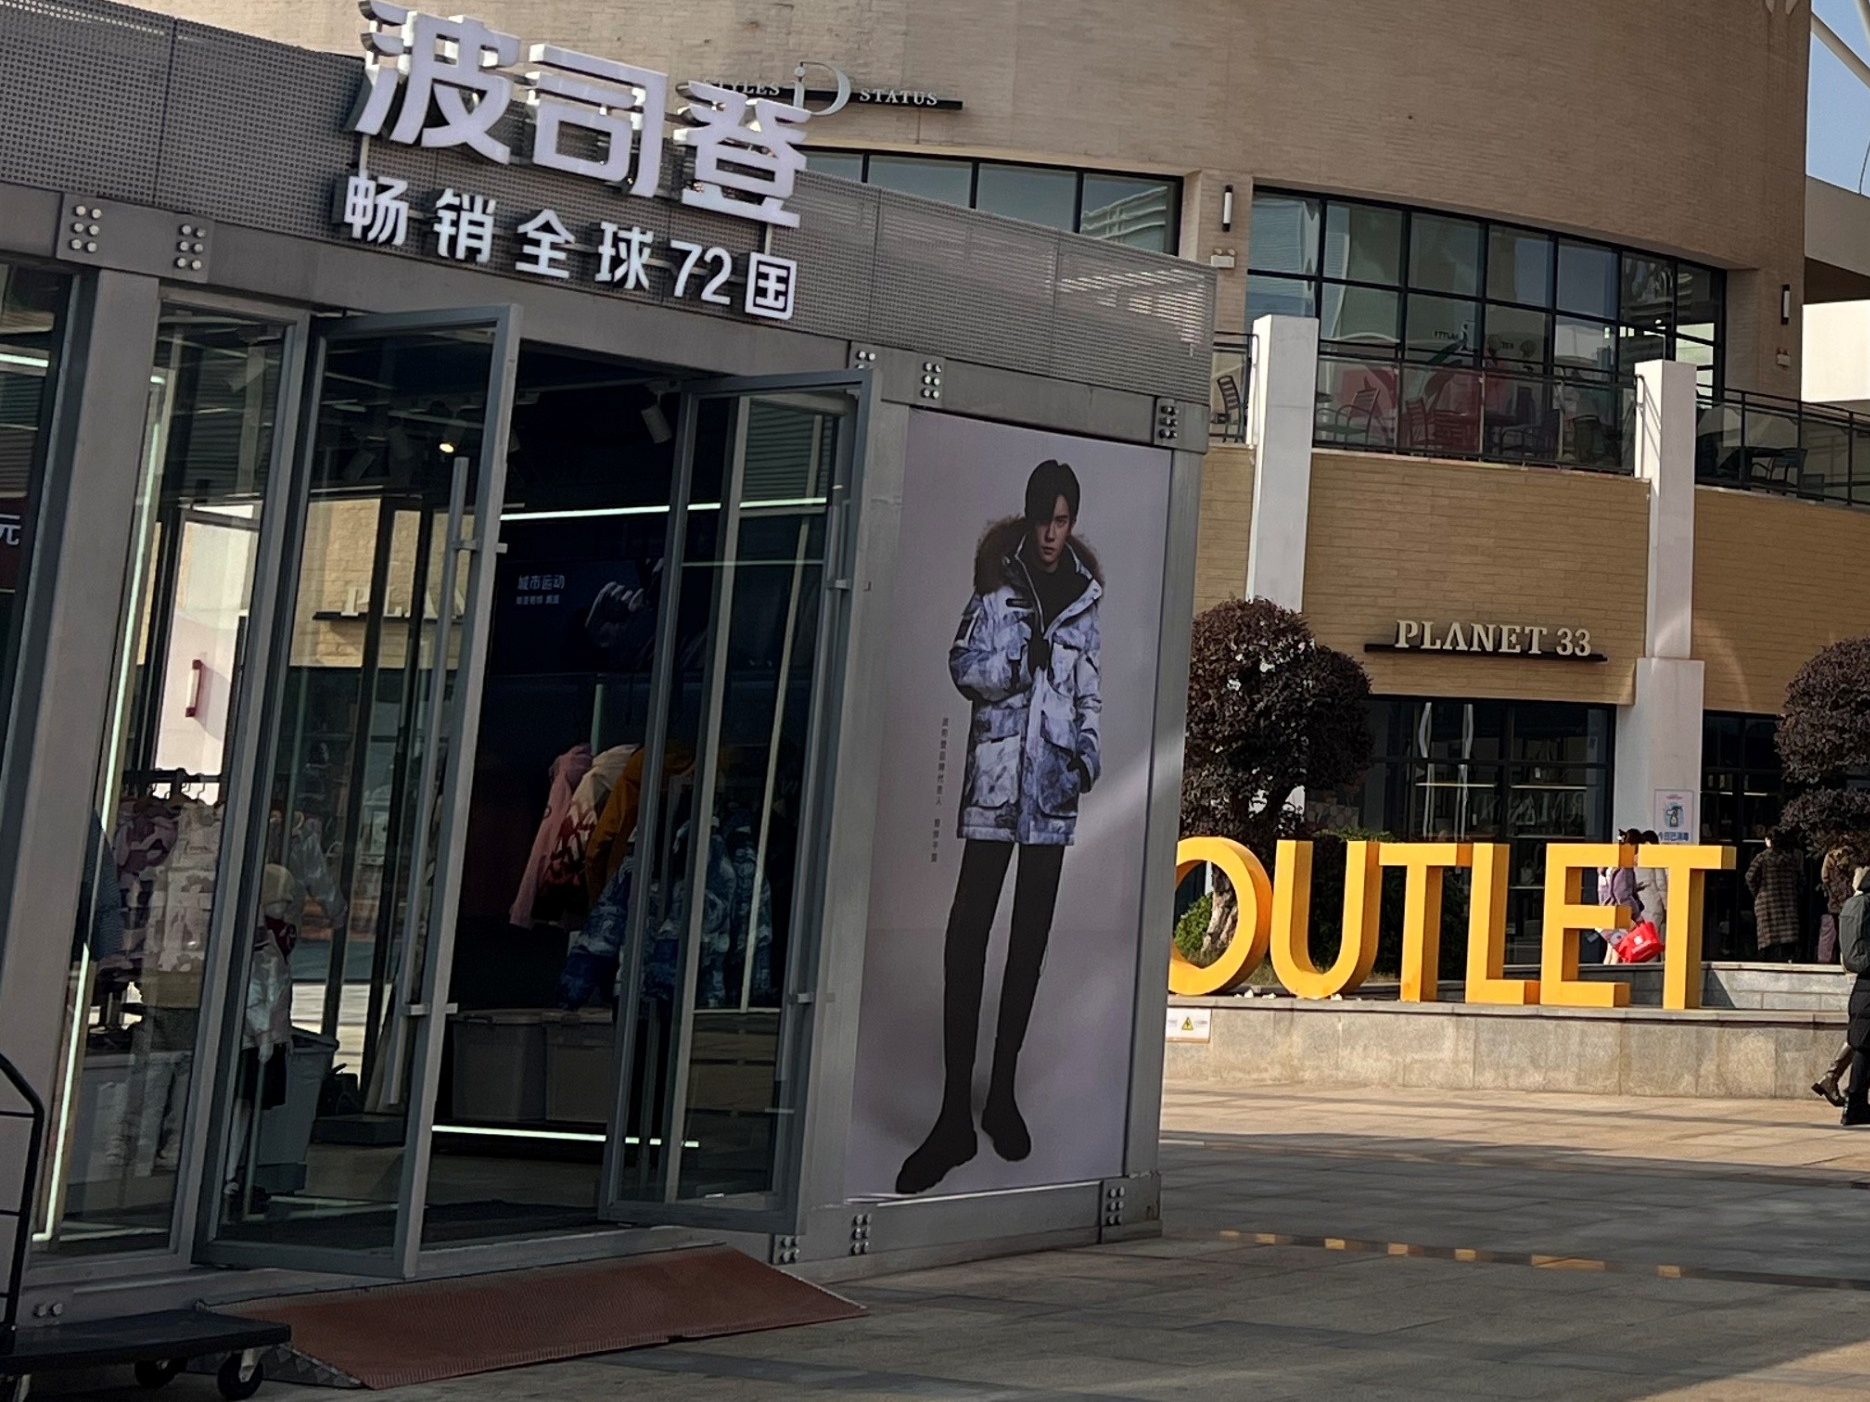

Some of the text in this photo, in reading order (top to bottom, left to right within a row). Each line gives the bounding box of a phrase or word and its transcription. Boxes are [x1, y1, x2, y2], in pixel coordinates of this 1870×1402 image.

[353, 0, 812, 229] 波司登
[859, 87, 938, 107] STATUS
[343, 173, 798, 321] 畅销全球72国
[1393, 619, 1592, 657] PLANET 33
[1166, 835, 1737, 1011] OUTLET
